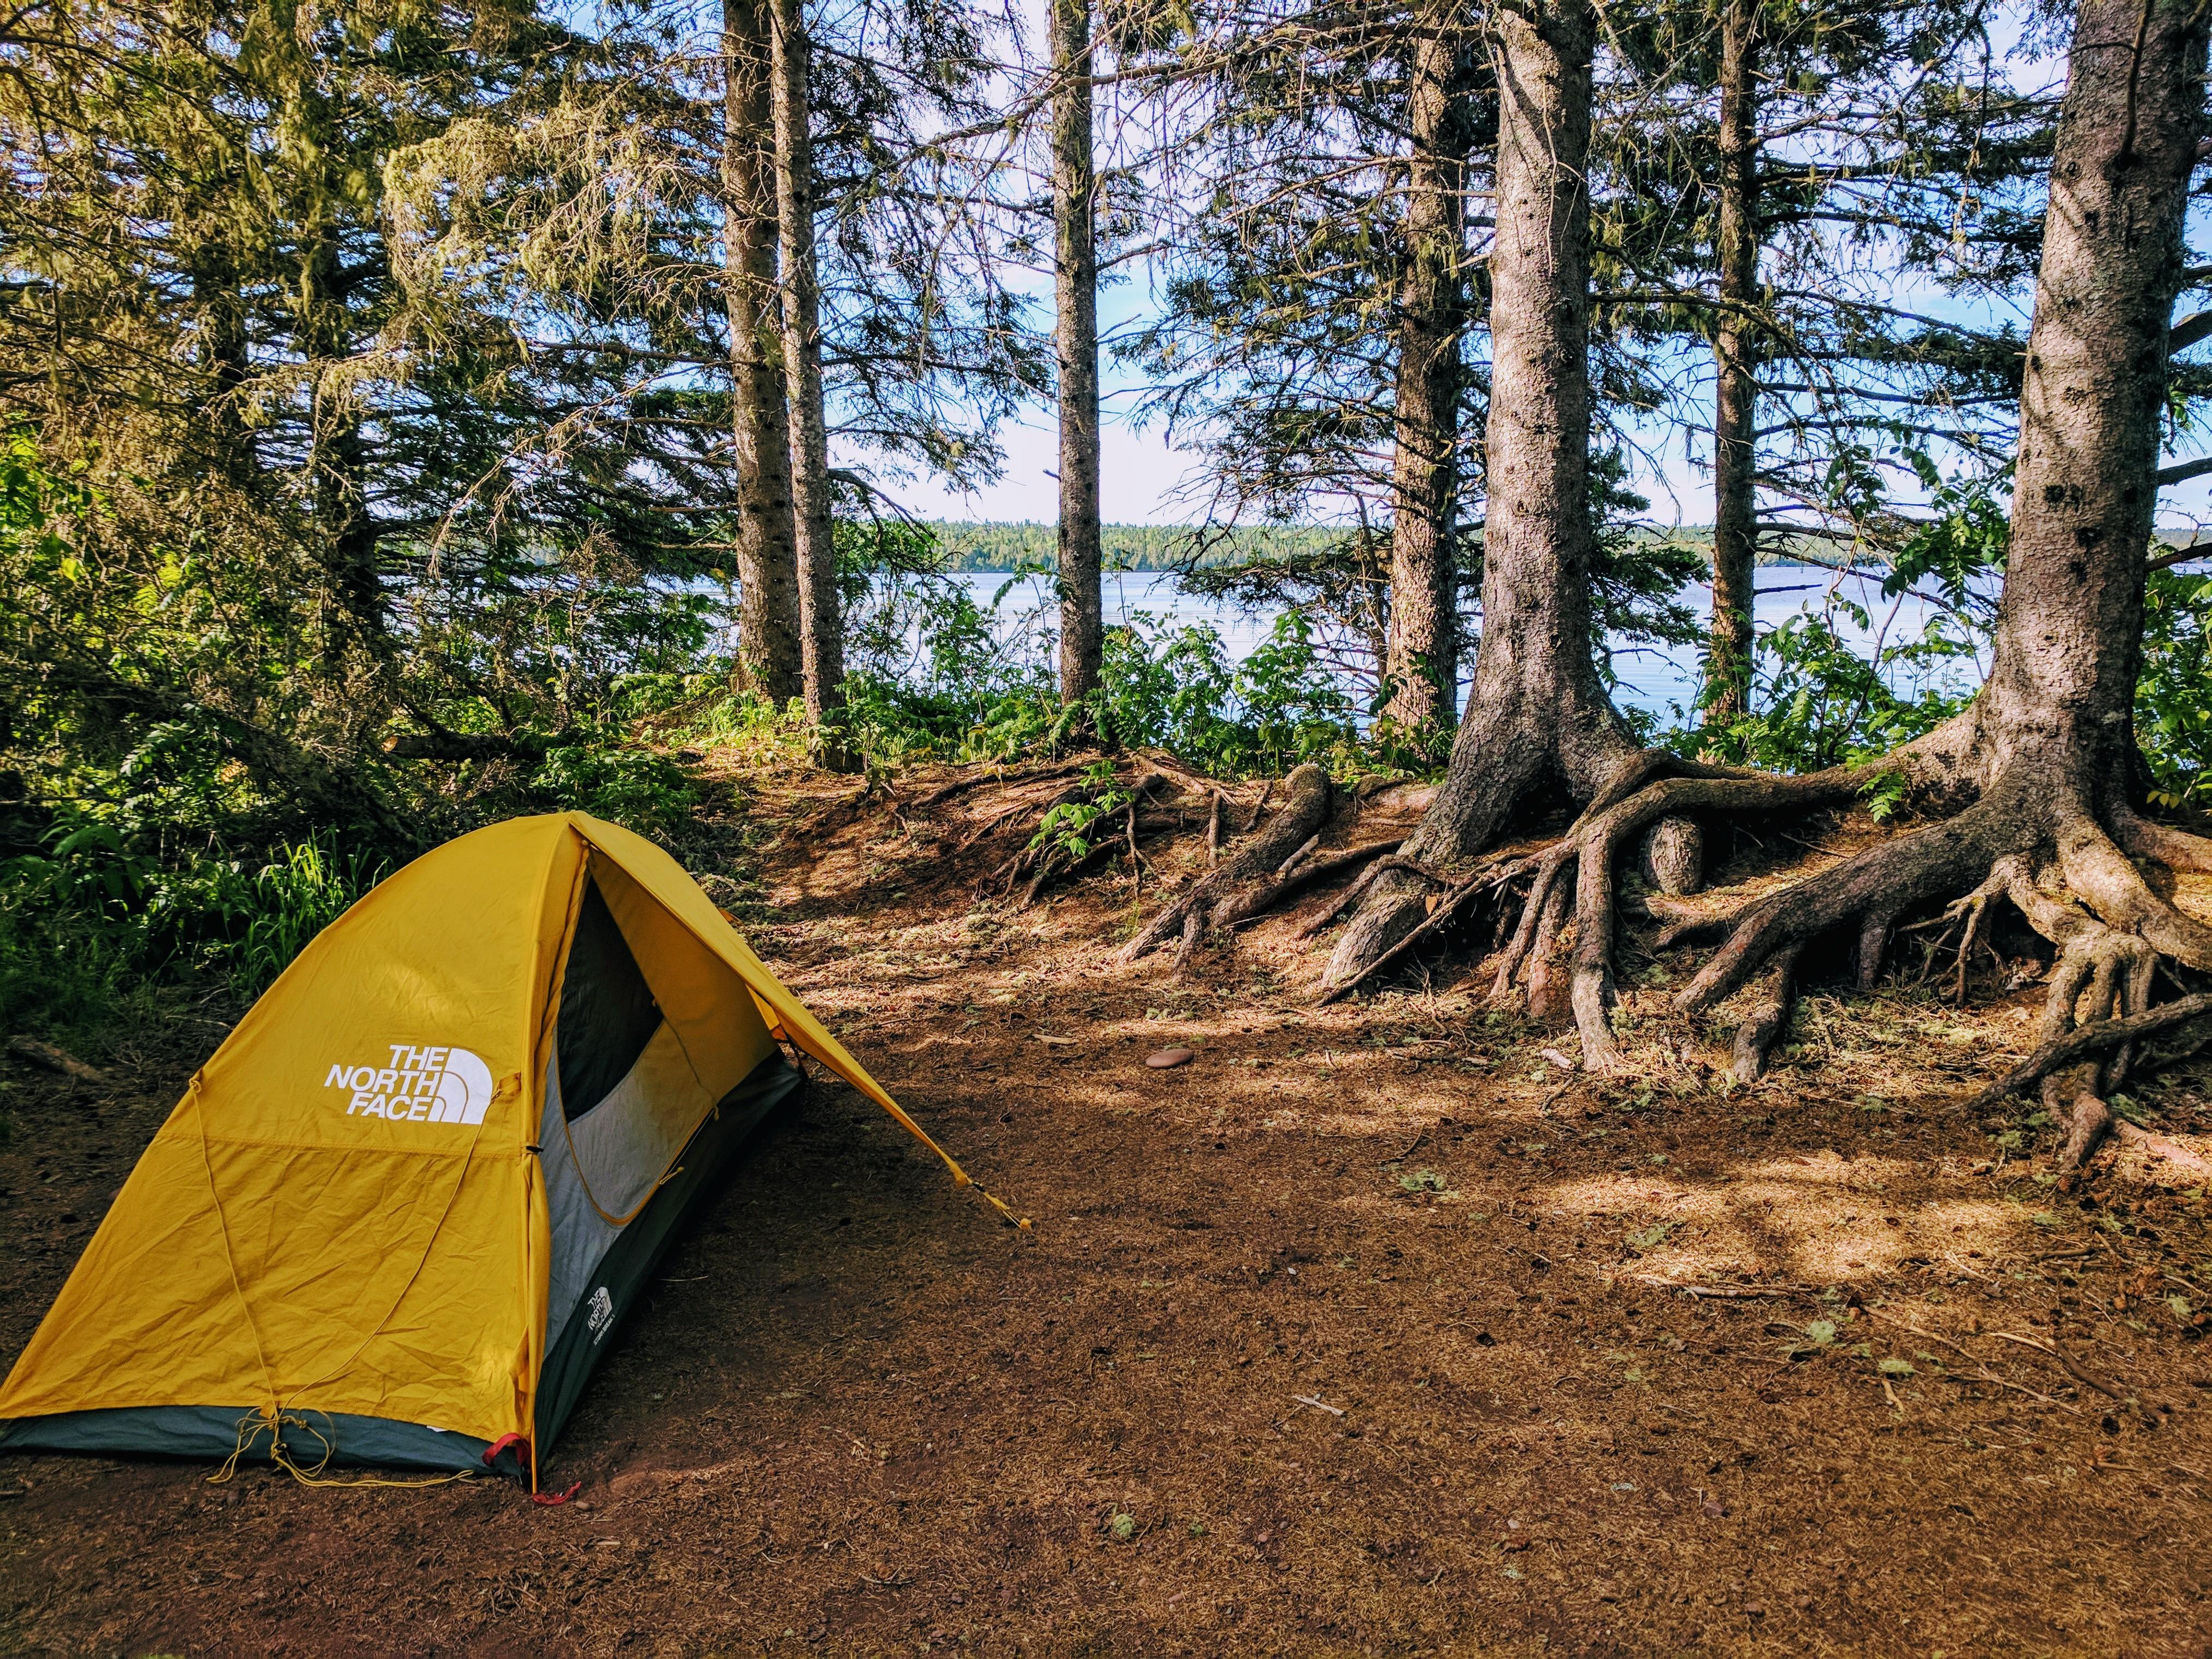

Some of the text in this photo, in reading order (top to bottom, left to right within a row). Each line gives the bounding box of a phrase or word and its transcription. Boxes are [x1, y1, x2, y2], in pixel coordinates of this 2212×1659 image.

[389, 1044, 449, 1072] THE
[323, 1064, 440, 1097] NORTH
[346, 1091, 432, 1122] FACE
[587, 1290, 602, 1309] THE
